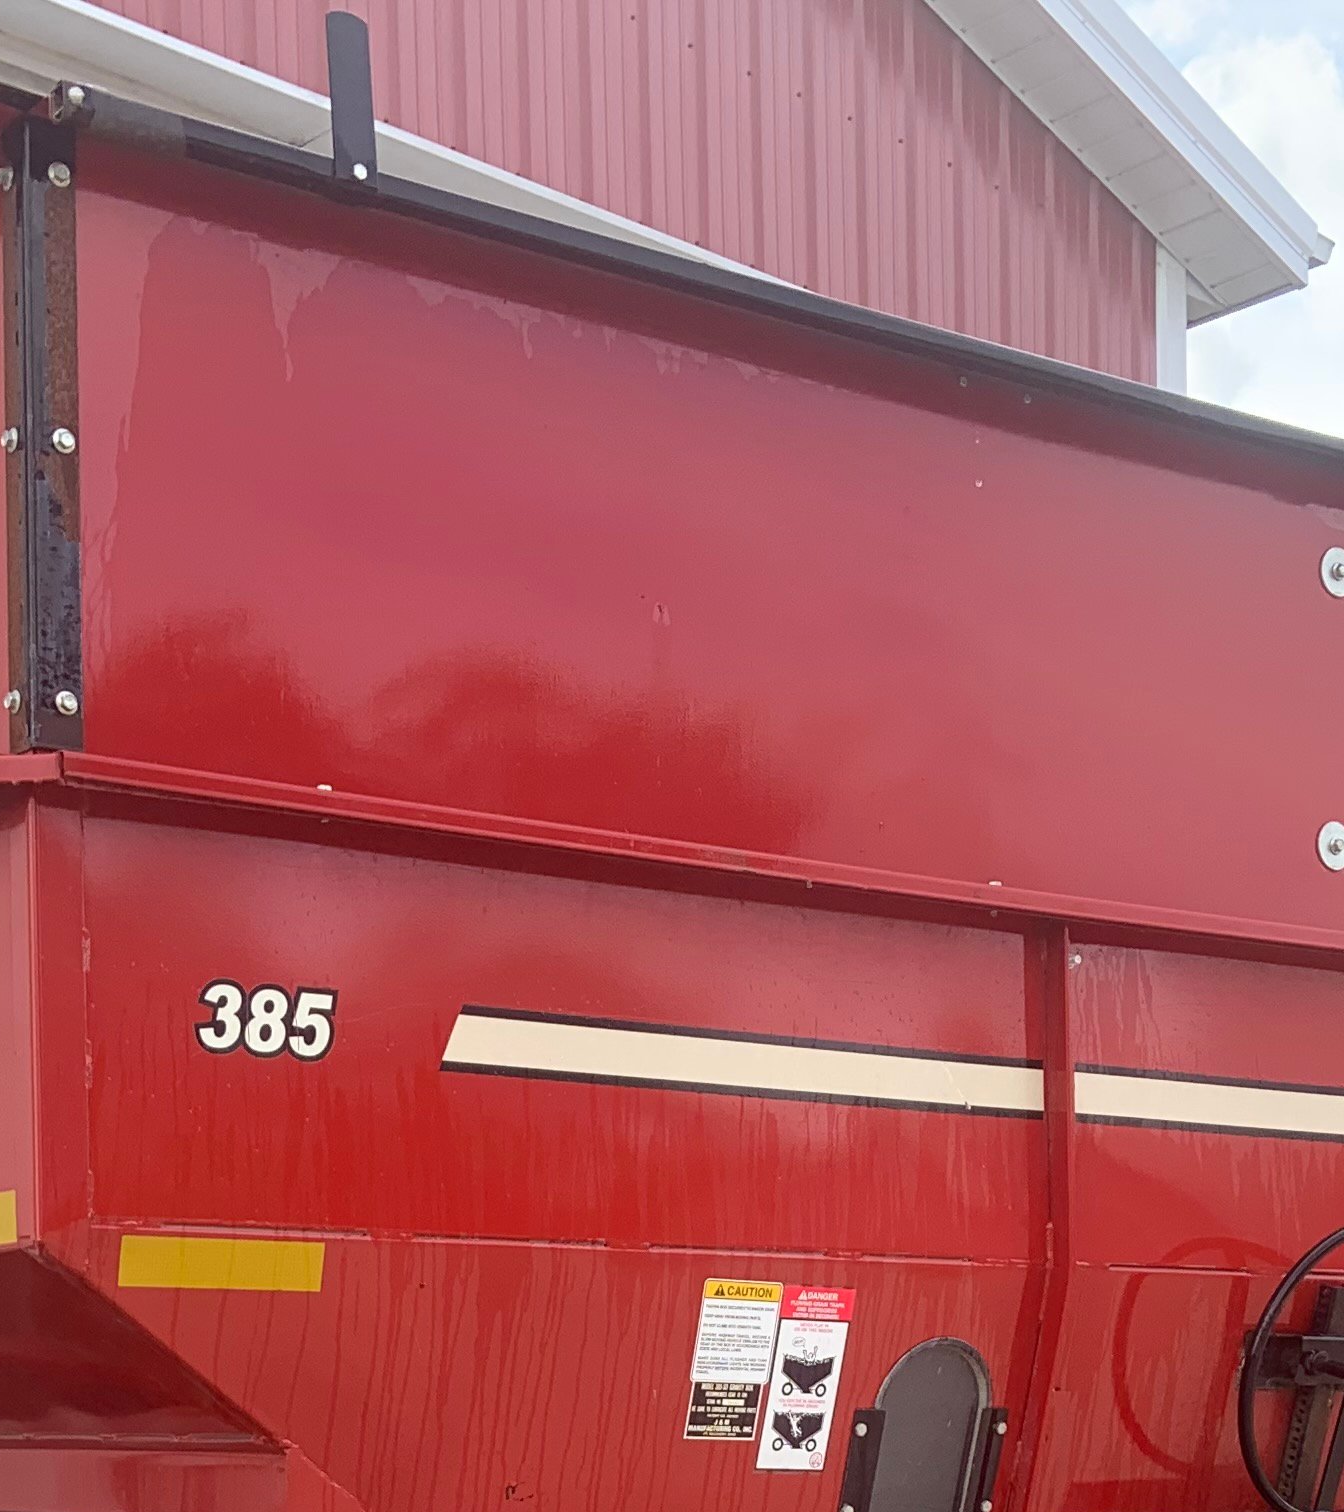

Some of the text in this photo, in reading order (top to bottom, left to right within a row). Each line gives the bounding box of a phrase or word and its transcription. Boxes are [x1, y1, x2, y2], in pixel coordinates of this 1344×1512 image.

[196, 980, 336, 1060] 385
[727, 1285, 773, 1298] CAUTION
[807, 1291, 839, 1301] DANGER
